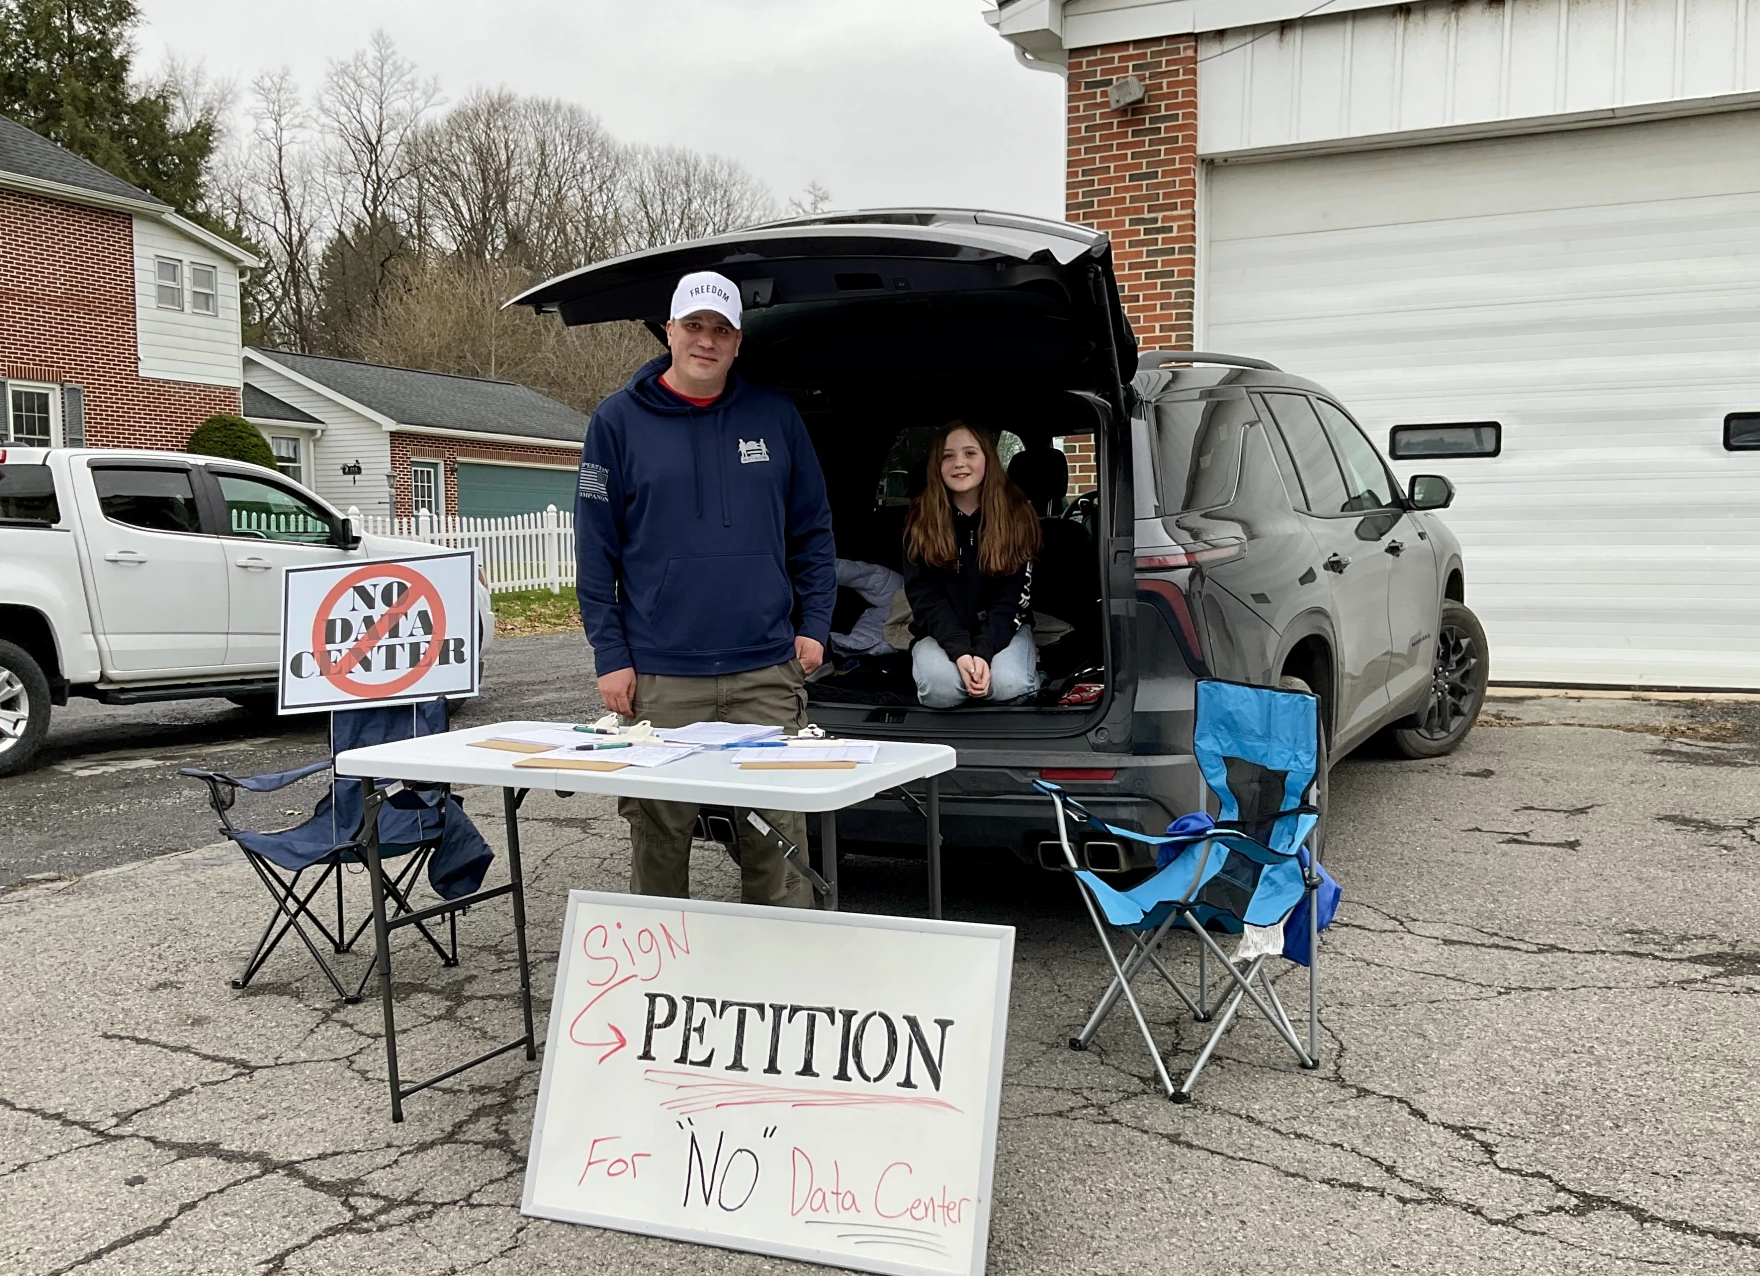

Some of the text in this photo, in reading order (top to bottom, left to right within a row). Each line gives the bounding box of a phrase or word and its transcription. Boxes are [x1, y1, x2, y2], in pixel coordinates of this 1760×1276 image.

[690, 285, 729, 302] FREEDOM
[349, 581, 410, 612] NO
[322, 609, 435, 645] DATA
[290, 637, 467, 678] CENTER
[636, 991, 955, 1092] PETITION
[578, 1136, 652, 1186] For
[791, 1147, 861, 1216] Data
[875, 1162, 971, 1225] Center
